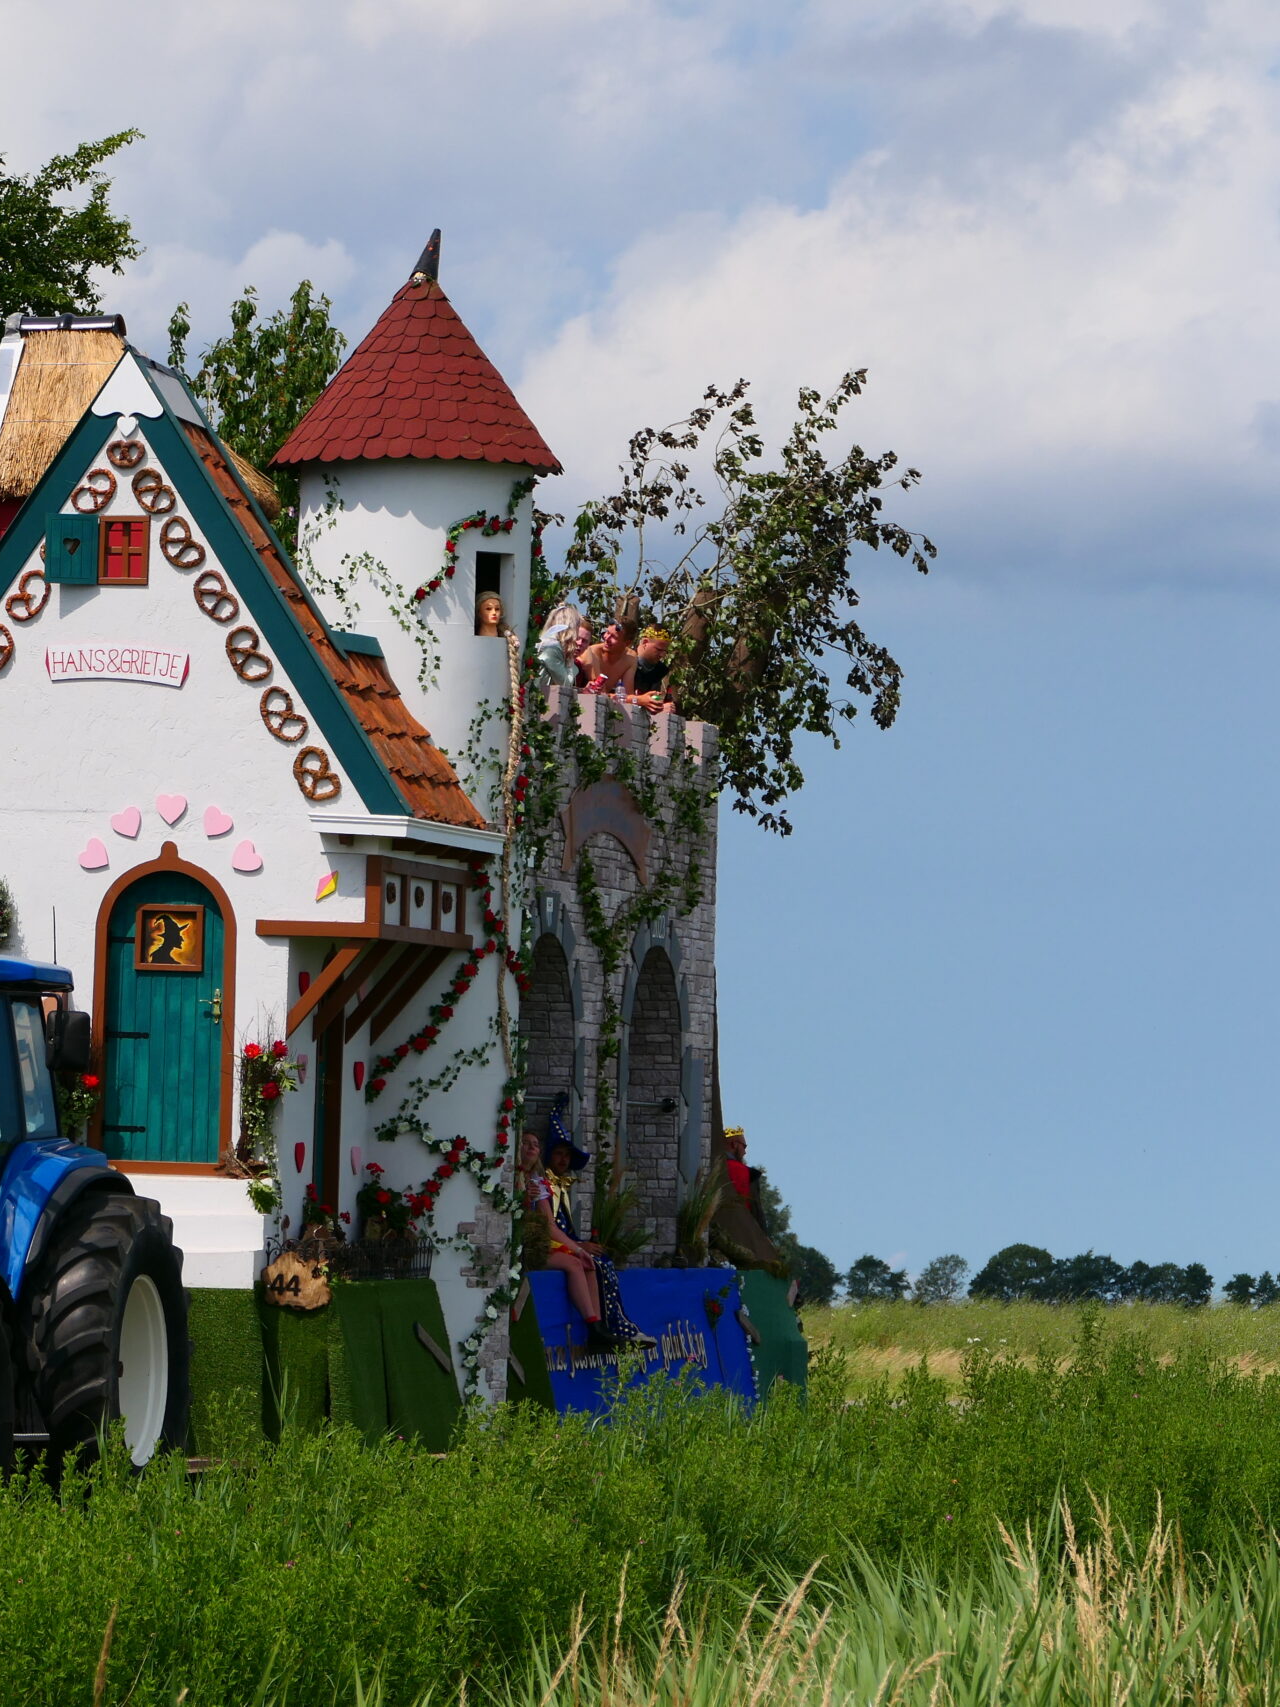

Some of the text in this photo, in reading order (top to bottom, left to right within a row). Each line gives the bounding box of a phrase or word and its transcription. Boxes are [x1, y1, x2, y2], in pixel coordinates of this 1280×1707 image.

[52, 648, 182, 679] HANS&GRIETJE
[270, 1273, 302, 1297] 44
[661, 1319, 708, 1372] gelukkig
